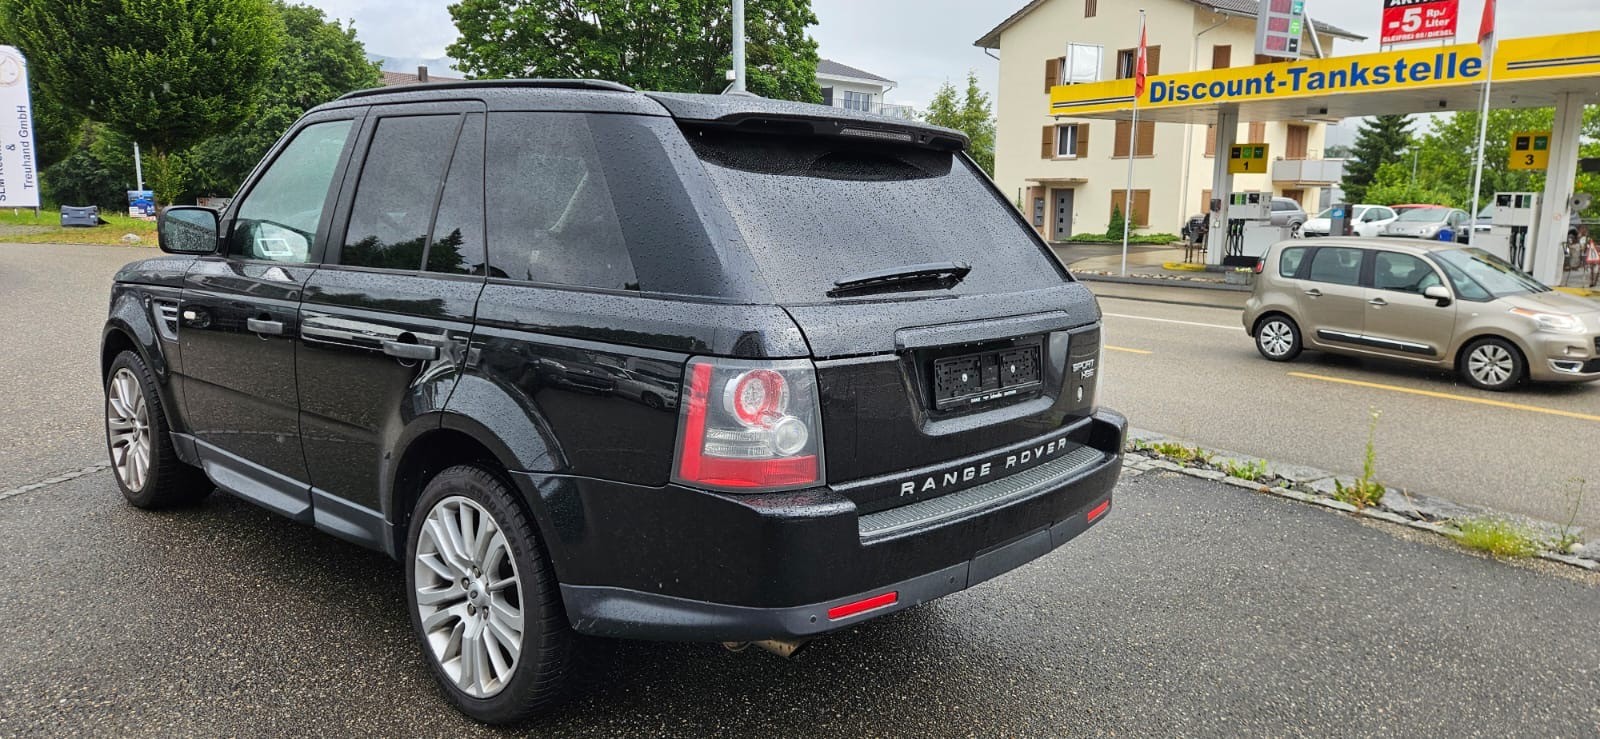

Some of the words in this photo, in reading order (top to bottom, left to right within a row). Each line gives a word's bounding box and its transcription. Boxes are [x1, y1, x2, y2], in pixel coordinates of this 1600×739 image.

[1388, 7, 1422, 33] -5
[1425, 19, 1450, 28] Liter
[1150, 52, 1482, 103] Discount-Tankstelle
[16, 105, 29, 138] GmbH
[20, 141, 33, 189] Treuhand
[1243, 161, 1249, 171] 1
[1525, 154, 1534, 165] 3
[1072, 358, 1095, 373] SPORT
[1081, 368, 1095, 380] HSE
[900, 462, 992, 497] RANGE
[1005, 437, 1067, 469] ROVER
